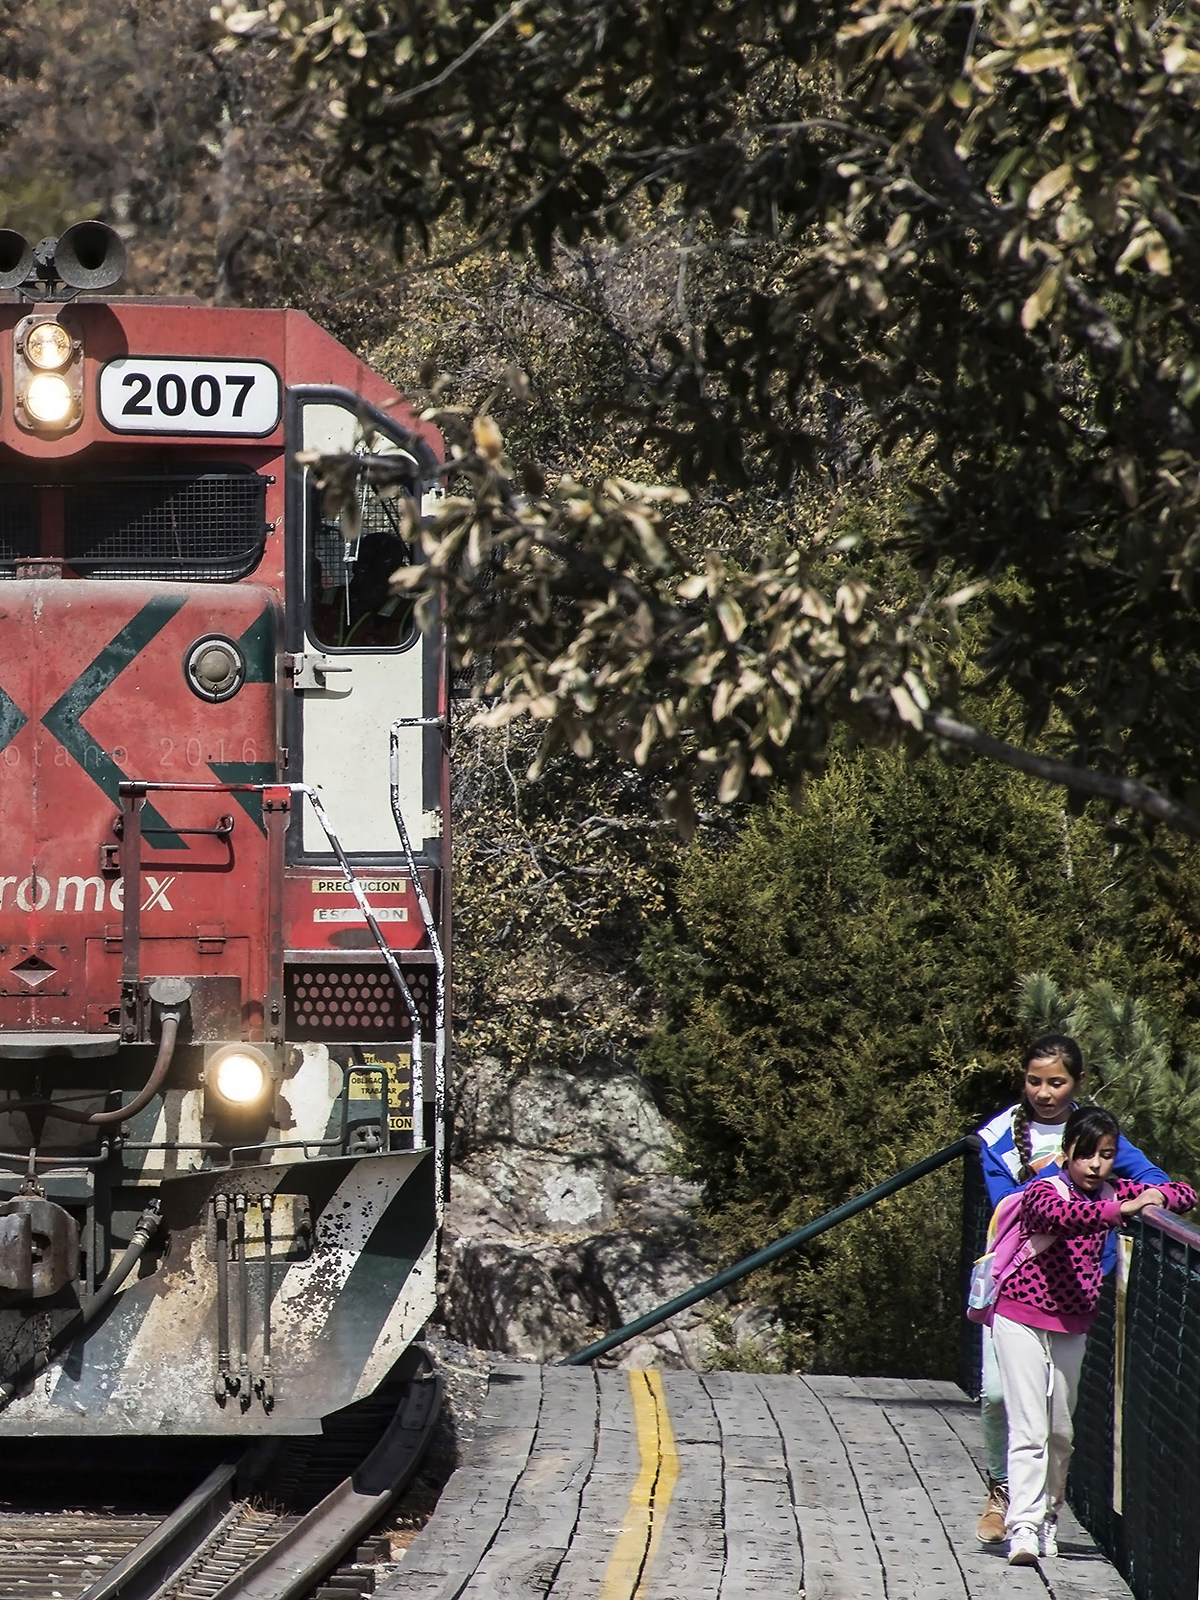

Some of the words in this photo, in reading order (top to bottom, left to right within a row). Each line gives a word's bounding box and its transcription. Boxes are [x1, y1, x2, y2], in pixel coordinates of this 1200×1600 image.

[121, 372, 256, 417] 2007
[319, 881, 400, 891] PRECUCION
[319, 909, 404, 920] ESON
[361, 1087, 397, 1095] TRABAAR
